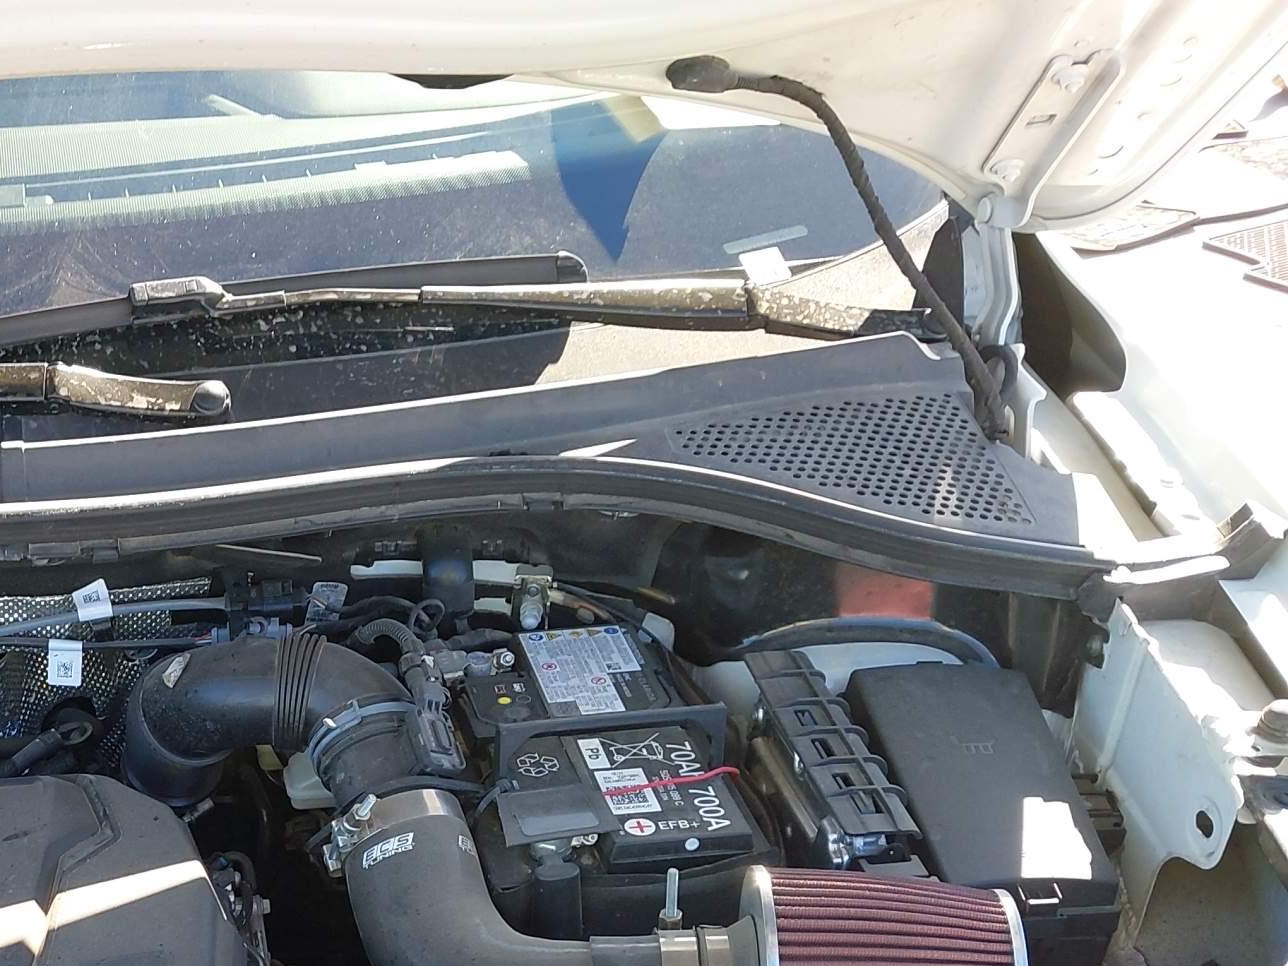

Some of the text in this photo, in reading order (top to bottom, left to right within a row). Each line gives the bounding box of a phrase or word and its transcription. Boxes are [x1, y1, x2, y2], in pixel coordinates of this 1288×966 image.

[585, 748, 601, 760] Pb
[688, 786, 731, 830] 700A
[658, 820, 700, 830] EFB+
